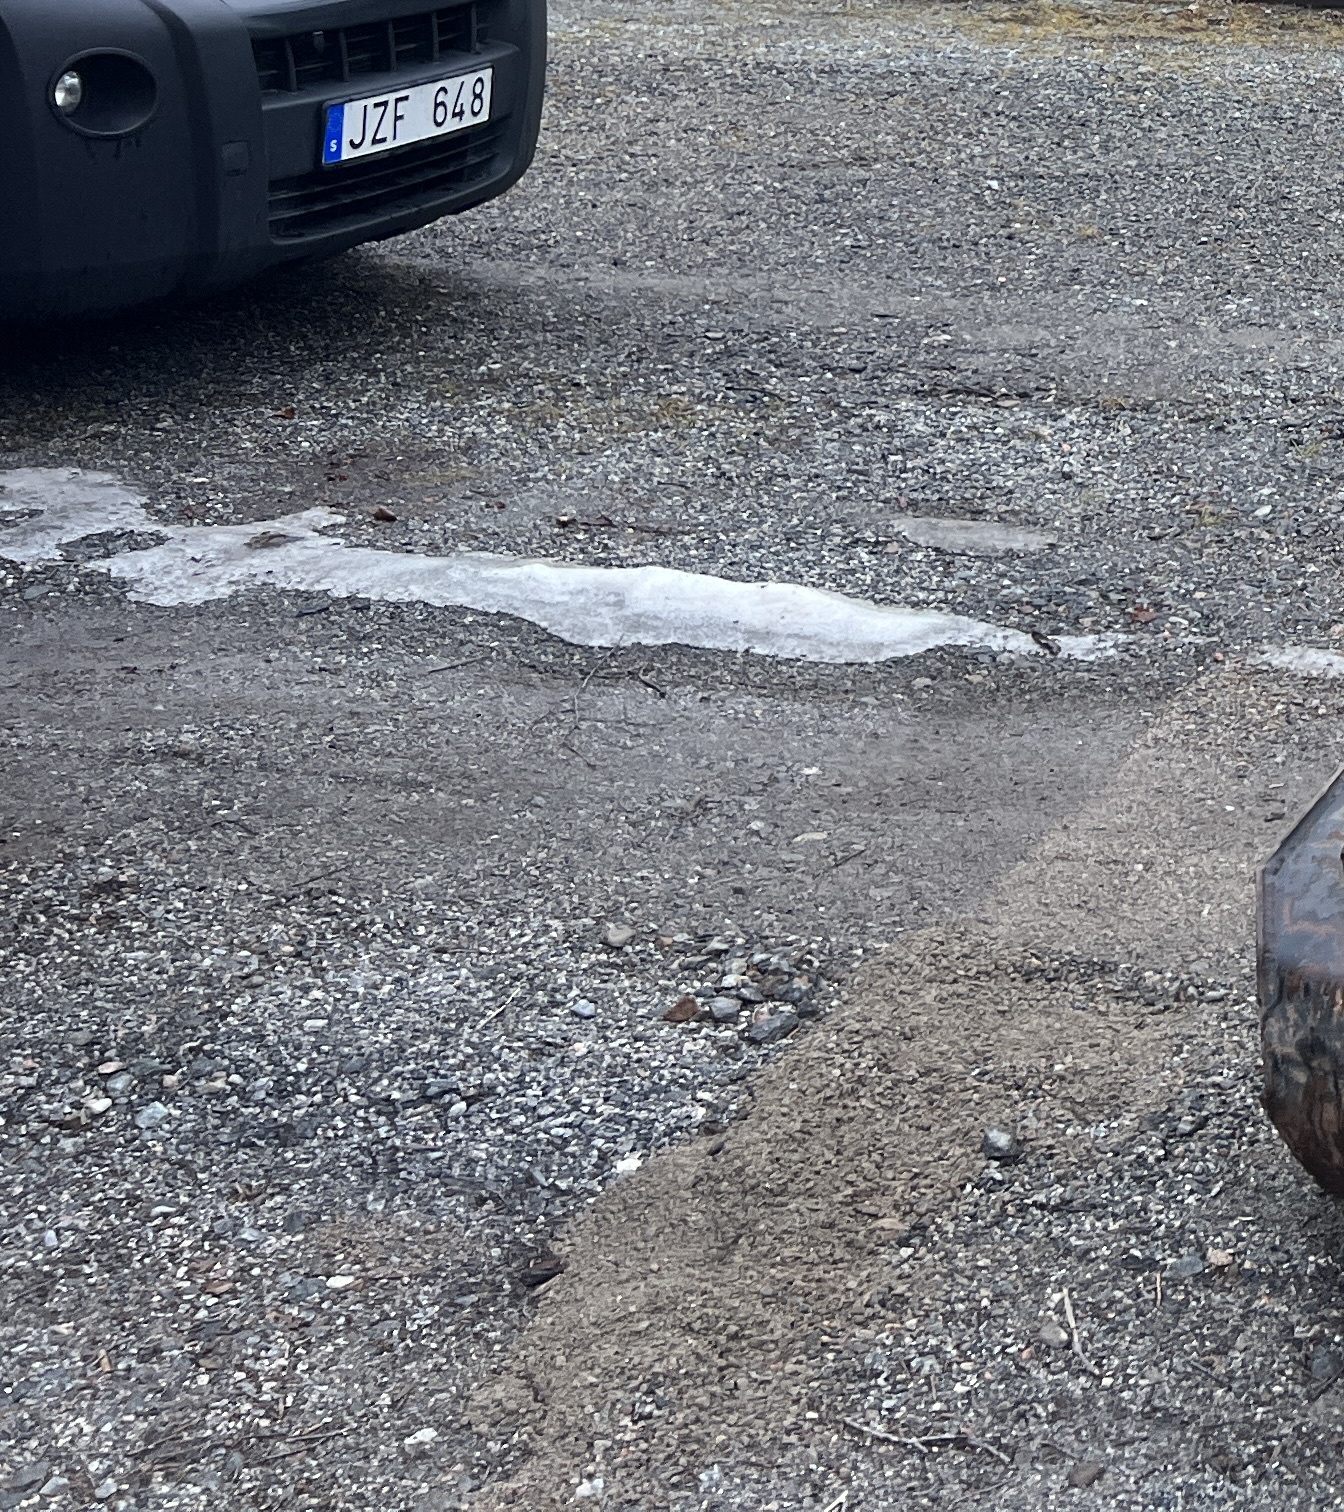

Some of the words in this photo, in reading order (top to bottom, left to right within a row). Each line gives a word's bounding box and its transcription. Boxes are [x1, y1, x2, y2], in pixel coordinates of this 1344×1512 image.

[349, 95, 410, 150] JZF
[433, 76, 485, 128] 648
[329, 139, 338, 153] S
